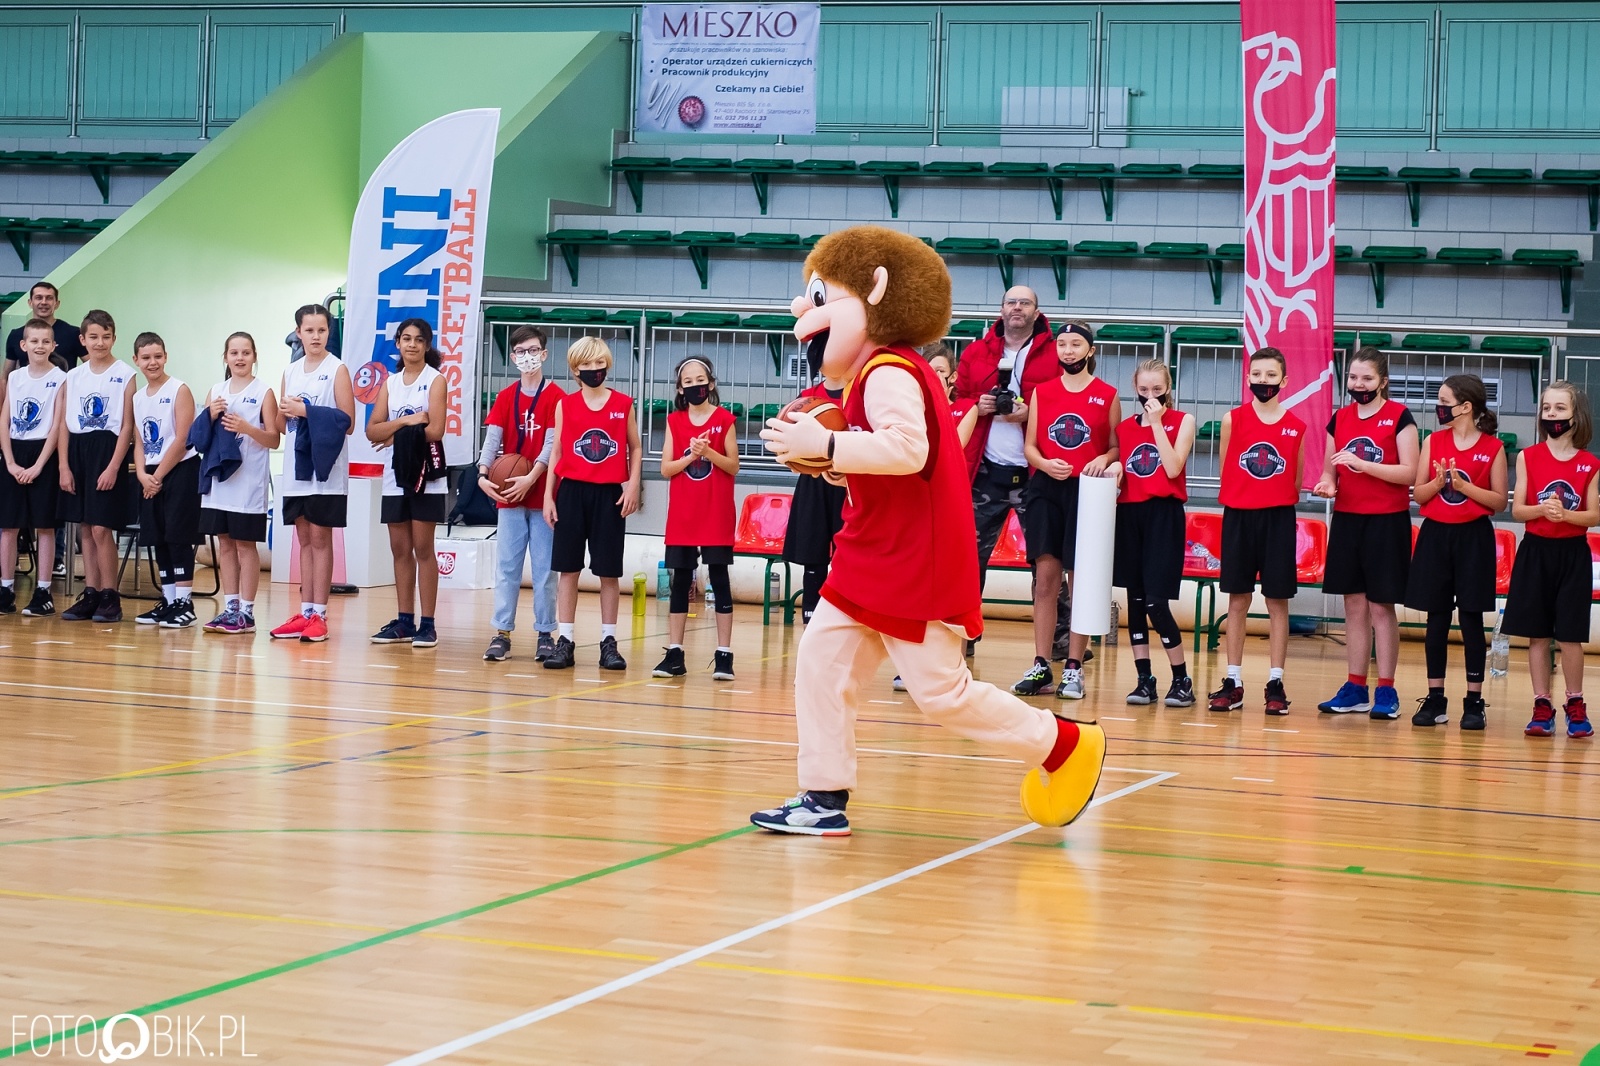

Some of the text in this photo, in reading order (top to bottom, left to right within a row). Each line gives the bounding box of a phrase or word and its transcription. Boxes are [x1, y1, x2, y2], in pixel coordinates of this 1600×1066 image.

[662, 11, 798, 38] MIESZKO
[662, 57, 813, 67] Operator urządzeń cukierniczych
[661, 68, 769, 78] Pracownik produkcyjny
[715, 84, 757, 94] Czekamy
[773, 84, 805, 93] Ciebie!
[437, 189, 477, 436] BASKETBALL
